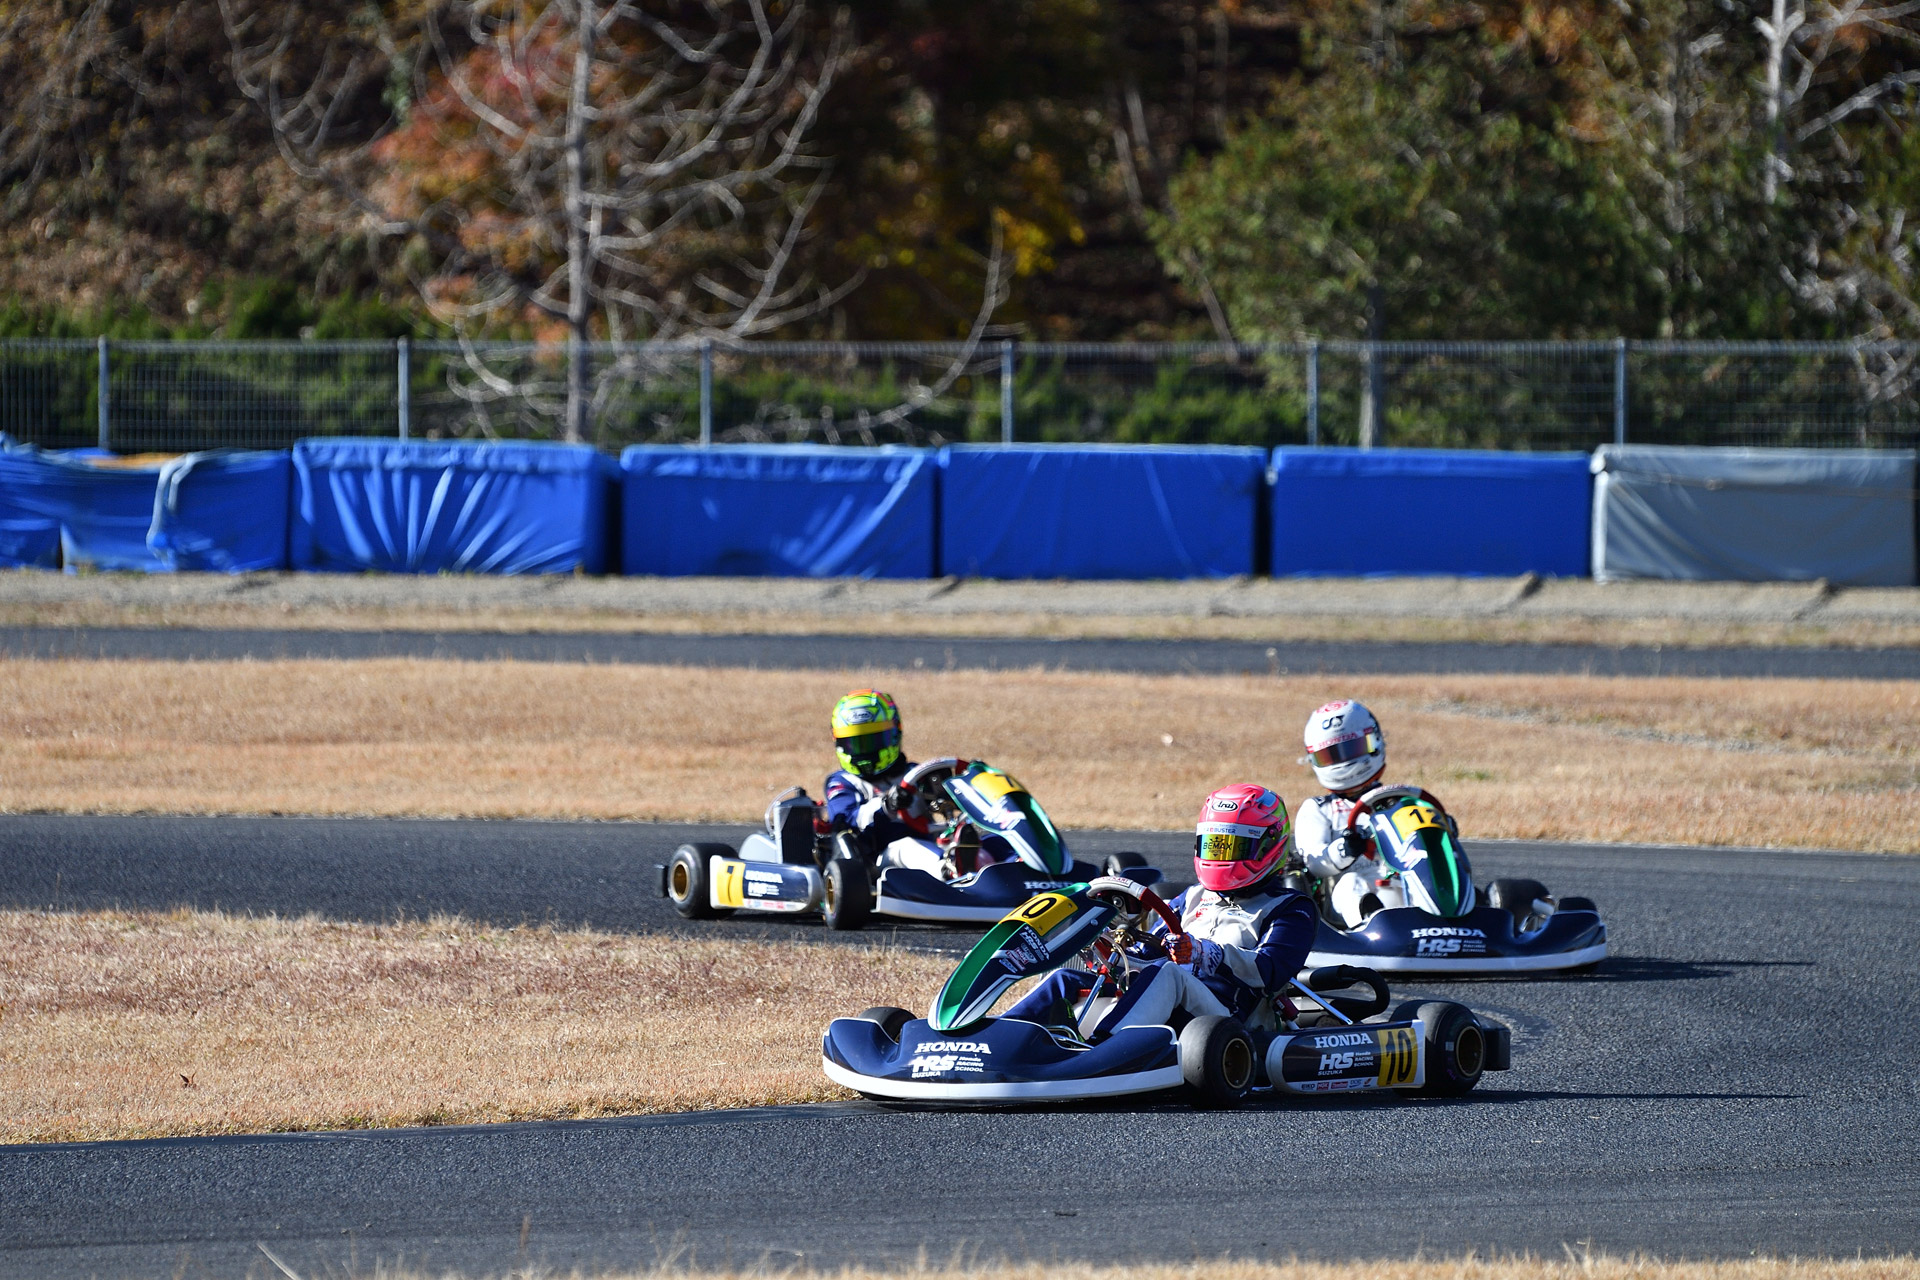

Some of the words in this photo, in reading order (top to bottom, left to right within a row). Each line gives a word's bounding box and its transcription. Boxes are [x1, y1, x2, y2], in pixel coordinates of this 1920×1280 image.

[1216, 801, 1236, 810] Arai
[1409, 809, 1446, 827] 12
[1203, 842, 1232, 850] BEMAX
[1411, 927, 1487, 938] HONDA
[1024, 925, 1050, 960] HONDA
[1418, 939, 1462, 952] HRS
[914, 1041, 991, 1054] HONDA
[1314, 1033, 1373, 1048] HONDA
[911, 1054, 958, 1072] HRS
[1319, 1052, 1354, 1070] HRS
[1385, 1030, 1412, 1085] 10
